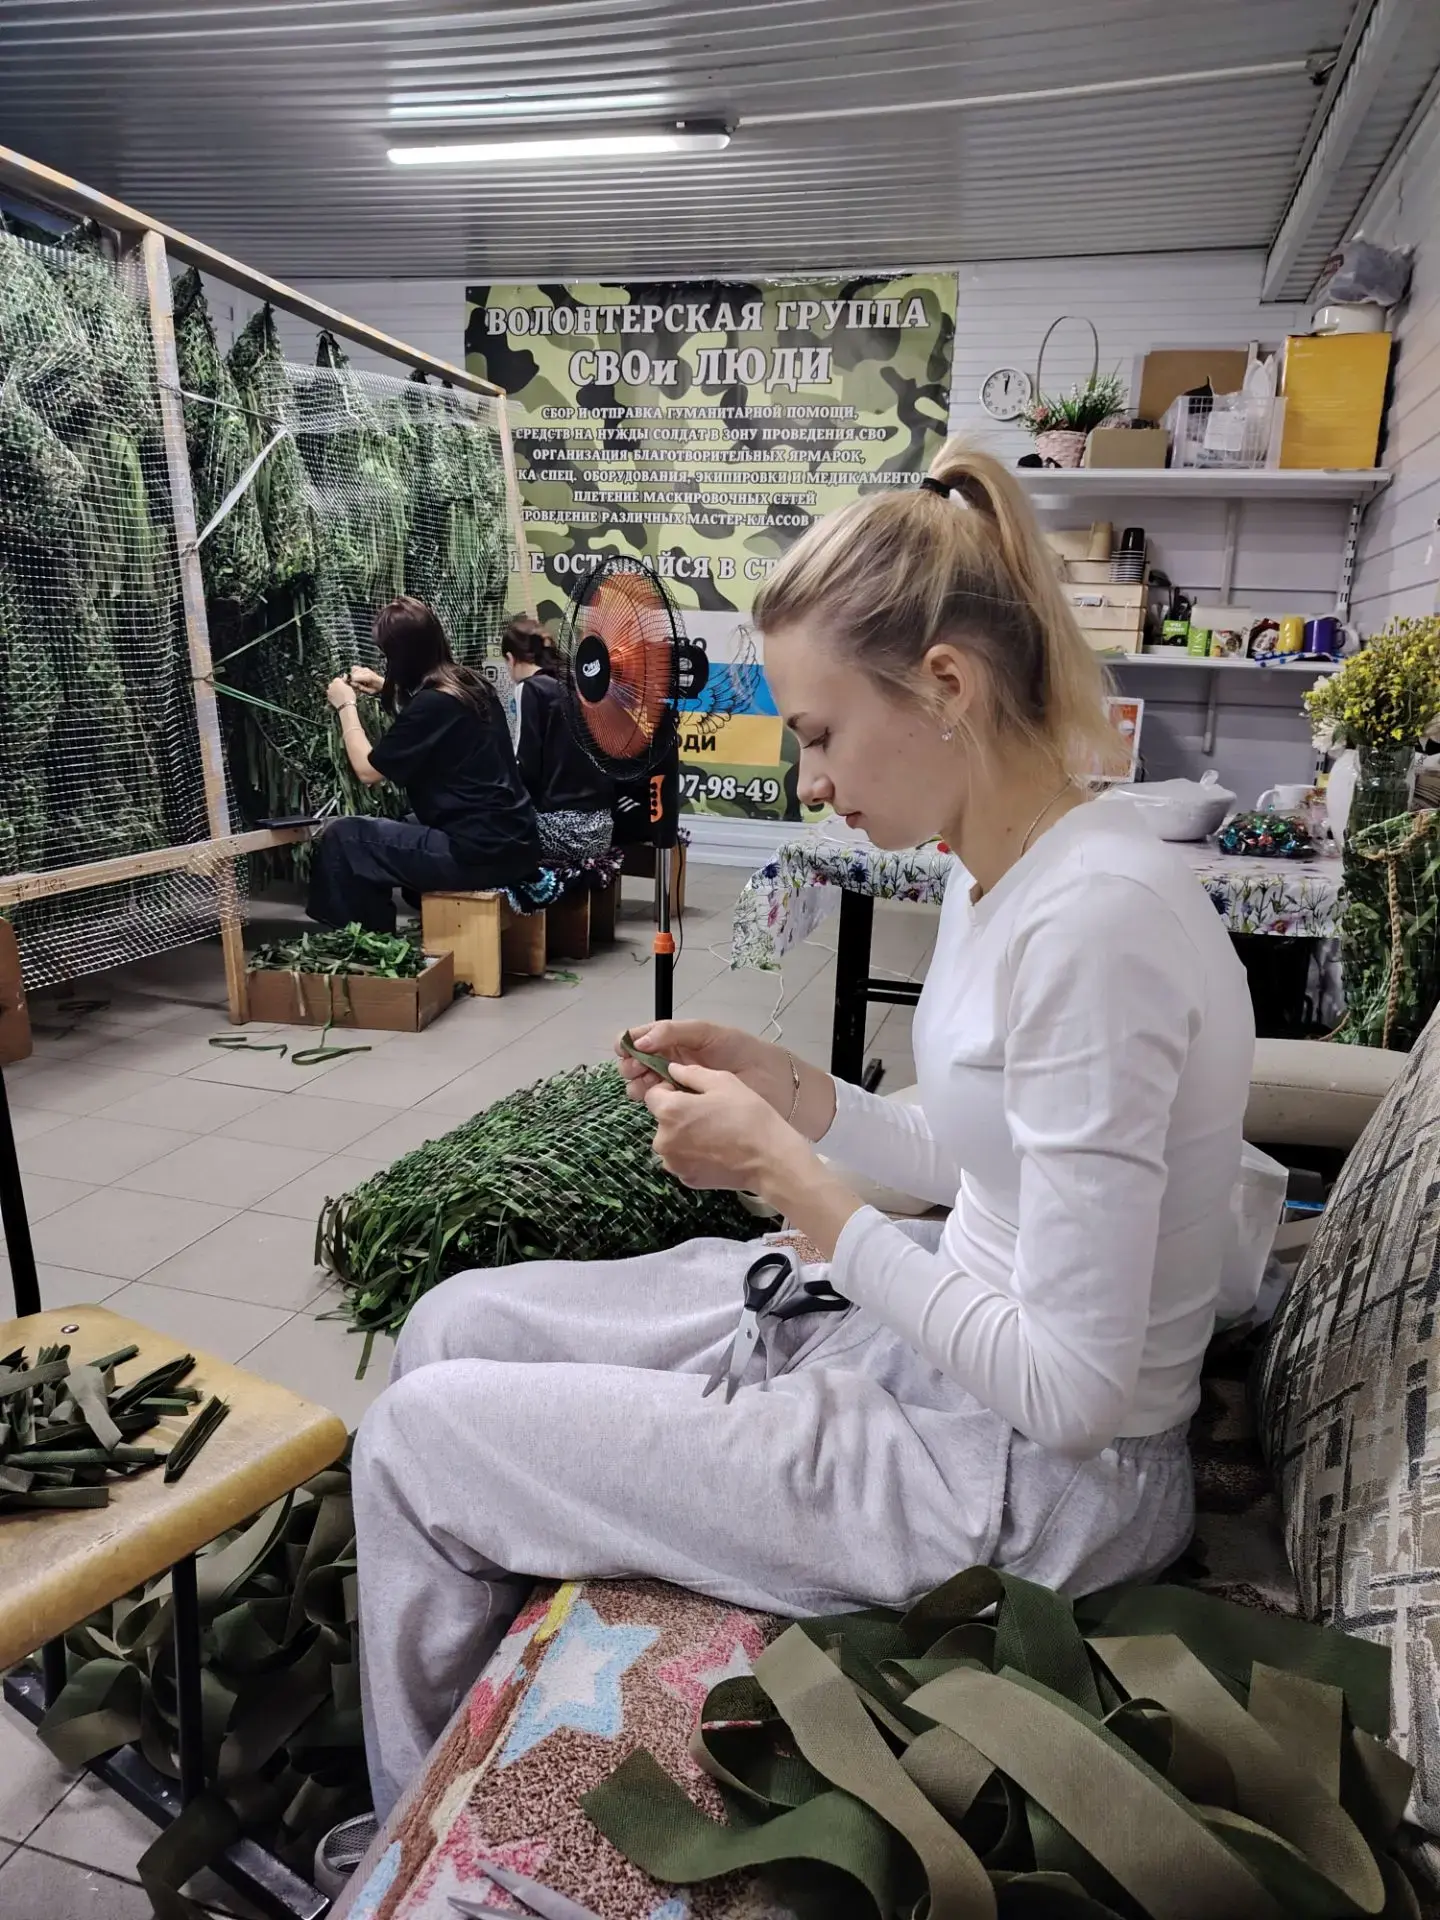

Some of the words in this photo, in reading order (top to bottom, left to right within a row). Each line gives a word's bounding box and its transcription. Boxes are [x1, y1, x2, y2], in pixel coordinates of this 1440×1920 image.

[486, 301, 765, 336] ВОЛОНТЕРСКАЯ
[775, 298, 930, 331] ГРУППА
[569, 349, 679, 387] СВОи
[691, 347, 833, 394] ЛЮДИ
[542, 407, 575, 419] СБОР
[577, 407, 591, 419] И
[591, 407, 663, 420] ОТПРАВКА
[667, 404, 782, 420] ГУМАНИТАРНОЙ
[786, 405, 859, 420] ПОМОЩИ,
[516, 428, 571, 442] СРЕДСТВ
[574, 428, 593, 441] НА
[596, 428, 650, 442] НУЖДЫ
[653, 428, 706, 443] СОЛДАТ
[709, 428, 720, 441] В
[723, 428, 758, 441] ЗОНУ
[761, 428, 858, 442] ПРОВЕДЕНИЯ
[859, 428, 887, 441] СВО
[532, 449, 629, 463] ОРГАНИЗАЦИЯ
[633, 449, 785, 463] БЛАГОТВОРИТЕЛЬНЫХ
[789, 450, 866, 465] ЯРМАРОК,
[540, 469, 578, 483] СПЕЦ.
[583, 469, 692, 485] ОБОРУДОВАНИЯ,
[694, 471, 788, 484] ЭКИПИРОВКИ
[790, 471, 803, 484] И
[573, 490, 640, 503] ПЛЕТЕНИЕ
[643, 491, 770, 505] МАСКИРОВОЧНЫХ
[773, 490, 817, 505] СЕТЕЙ
[522, 509, 598, 524] РОВЕДЕНИЕ
[601, 511, 683, 524] РАЗЛИЧНЫХ
[686, 512, 810, 527] МАСТЕР-КЛАССОВ
[717, 557, 736, 579] В
